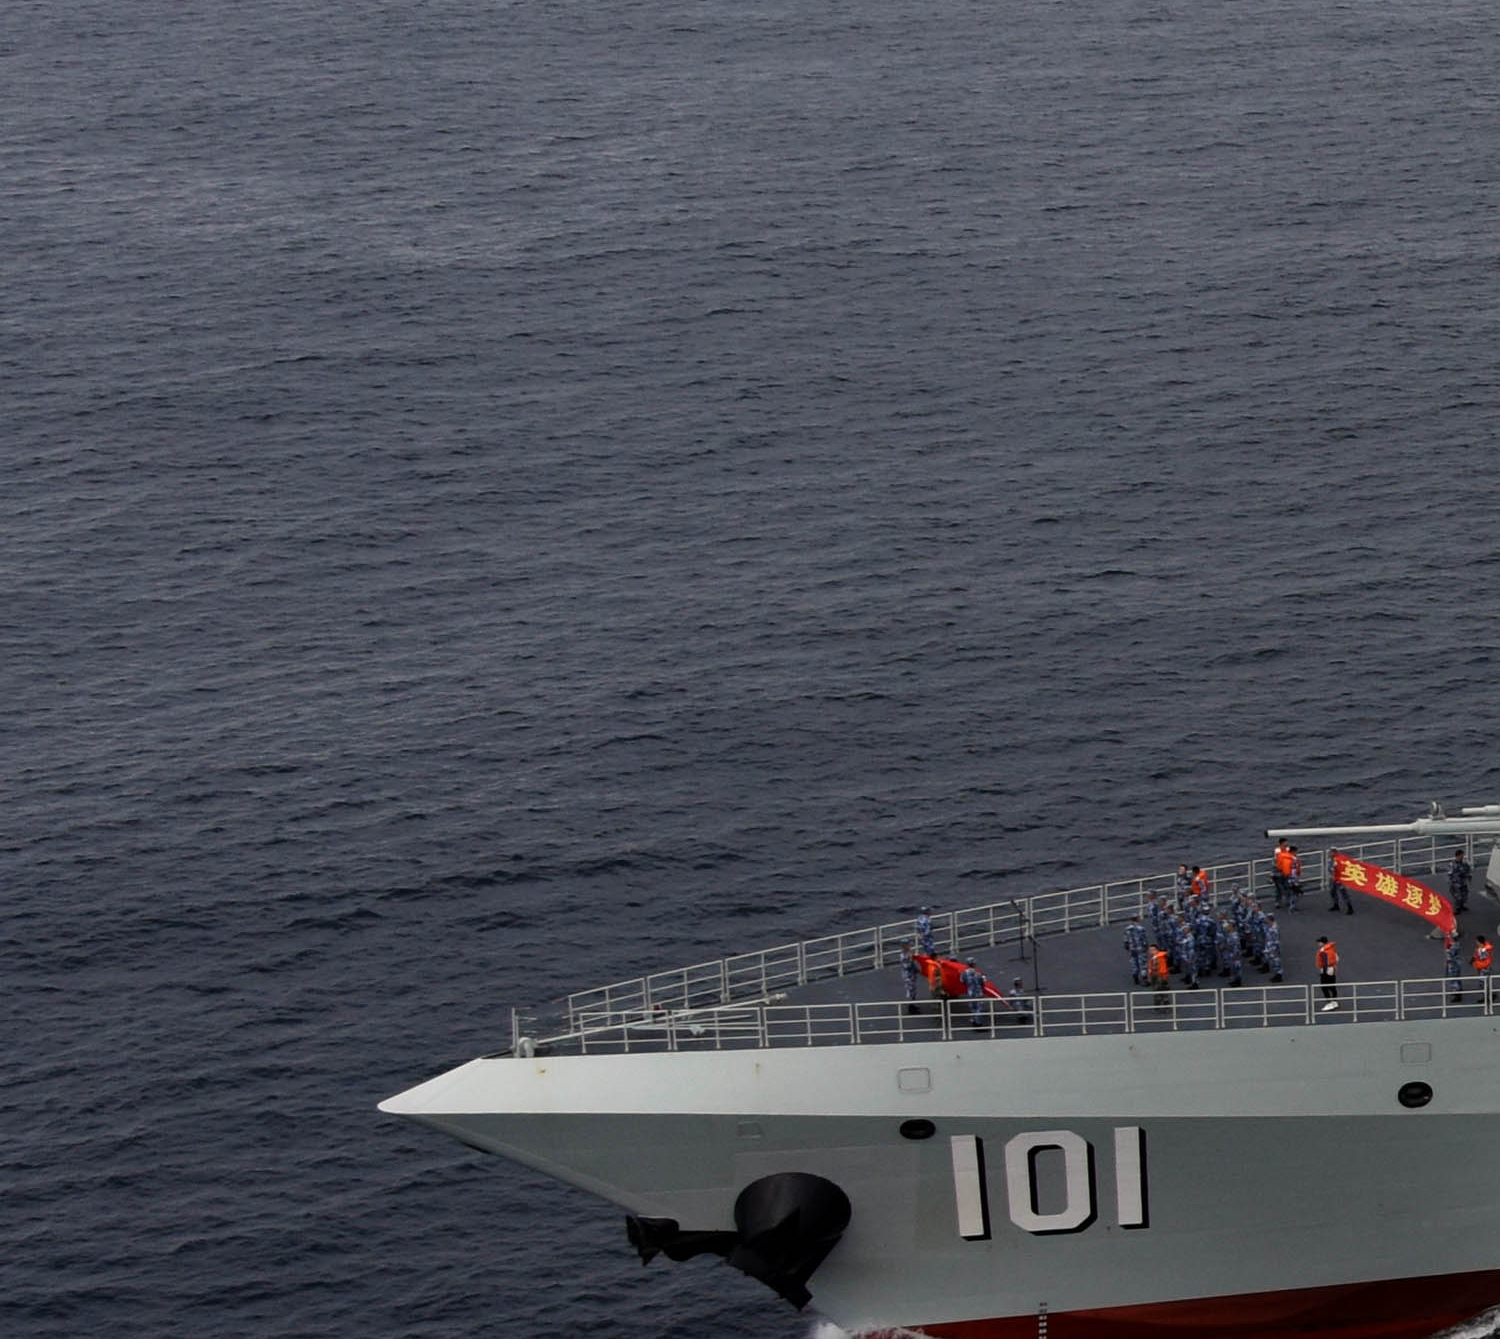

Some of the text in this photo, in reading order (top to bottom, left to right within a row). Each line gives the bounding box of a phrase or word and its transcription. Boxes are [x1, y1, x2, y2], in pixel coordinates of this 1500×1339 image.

[1340, 860, 1442, 916] 英雄逐梦
[951, 1126, 1148, 1240] 101
